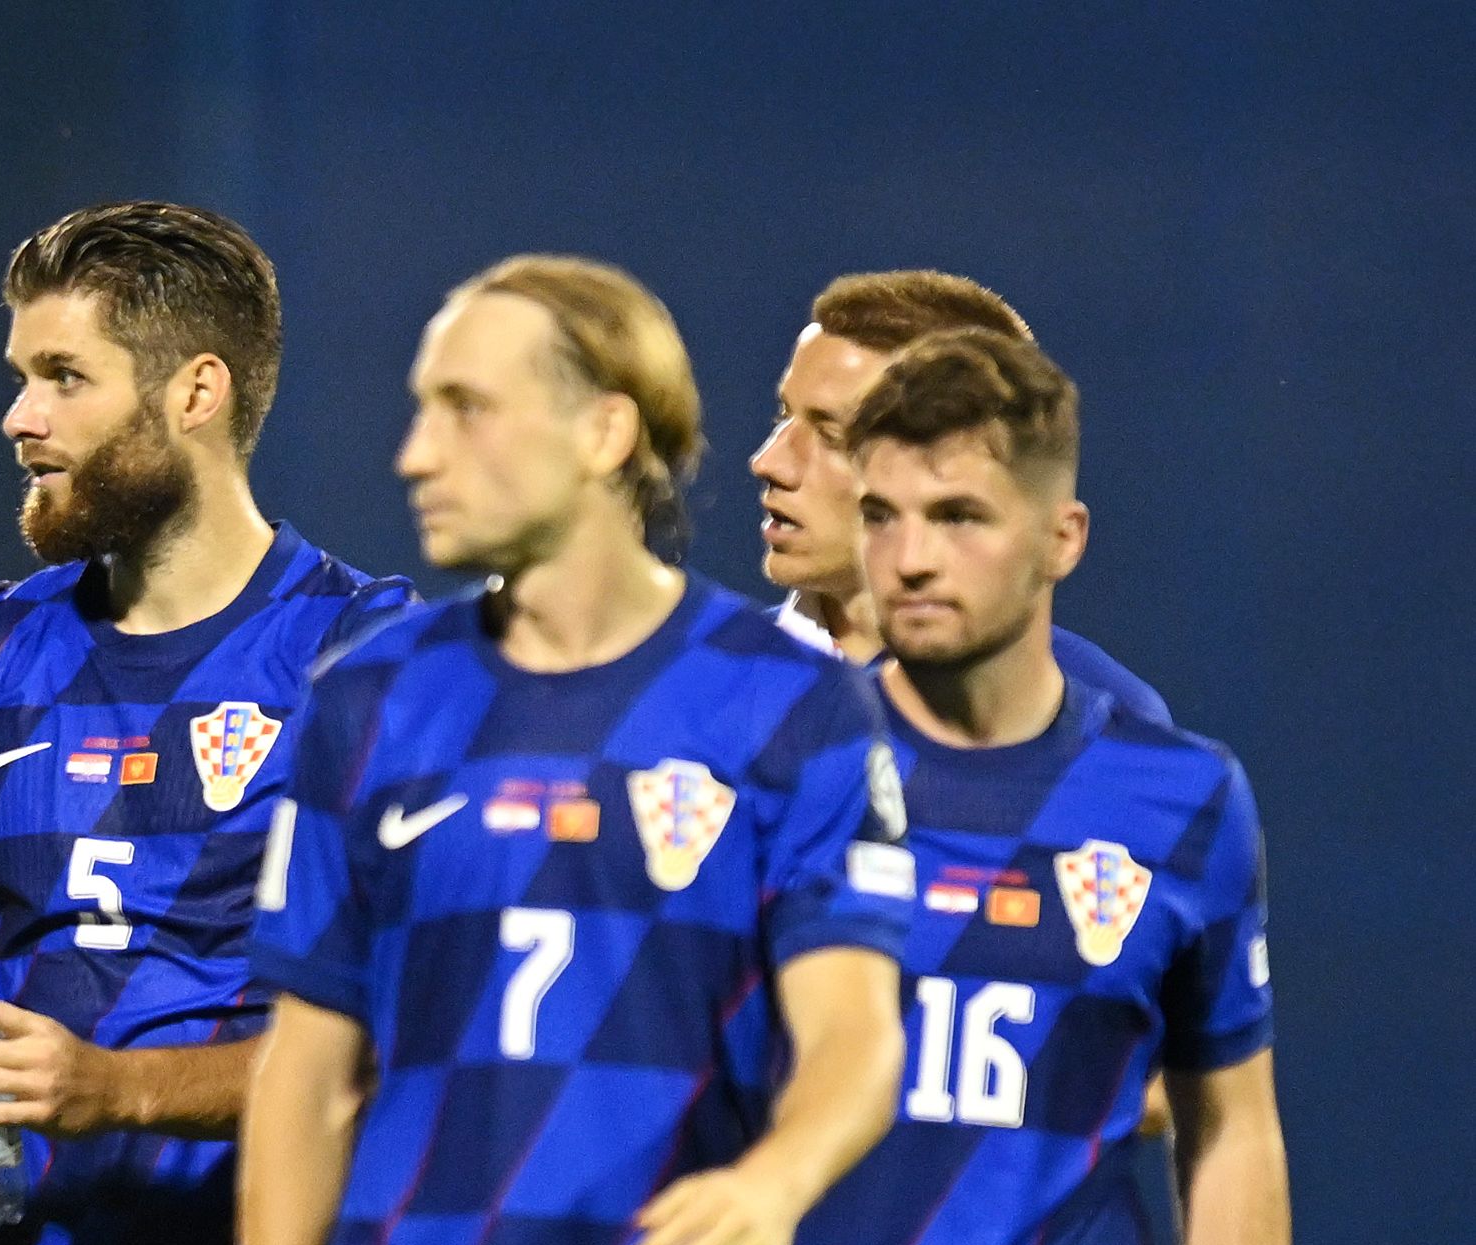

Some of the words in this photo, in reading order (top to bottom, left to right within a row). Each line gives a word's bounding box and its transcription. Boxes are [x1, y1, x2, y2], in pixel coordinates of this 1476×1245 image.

[67, 838, 135, 950] 5
[499, 906, 576, 1060] 7
[905, 976, 1036, 1129] 16
